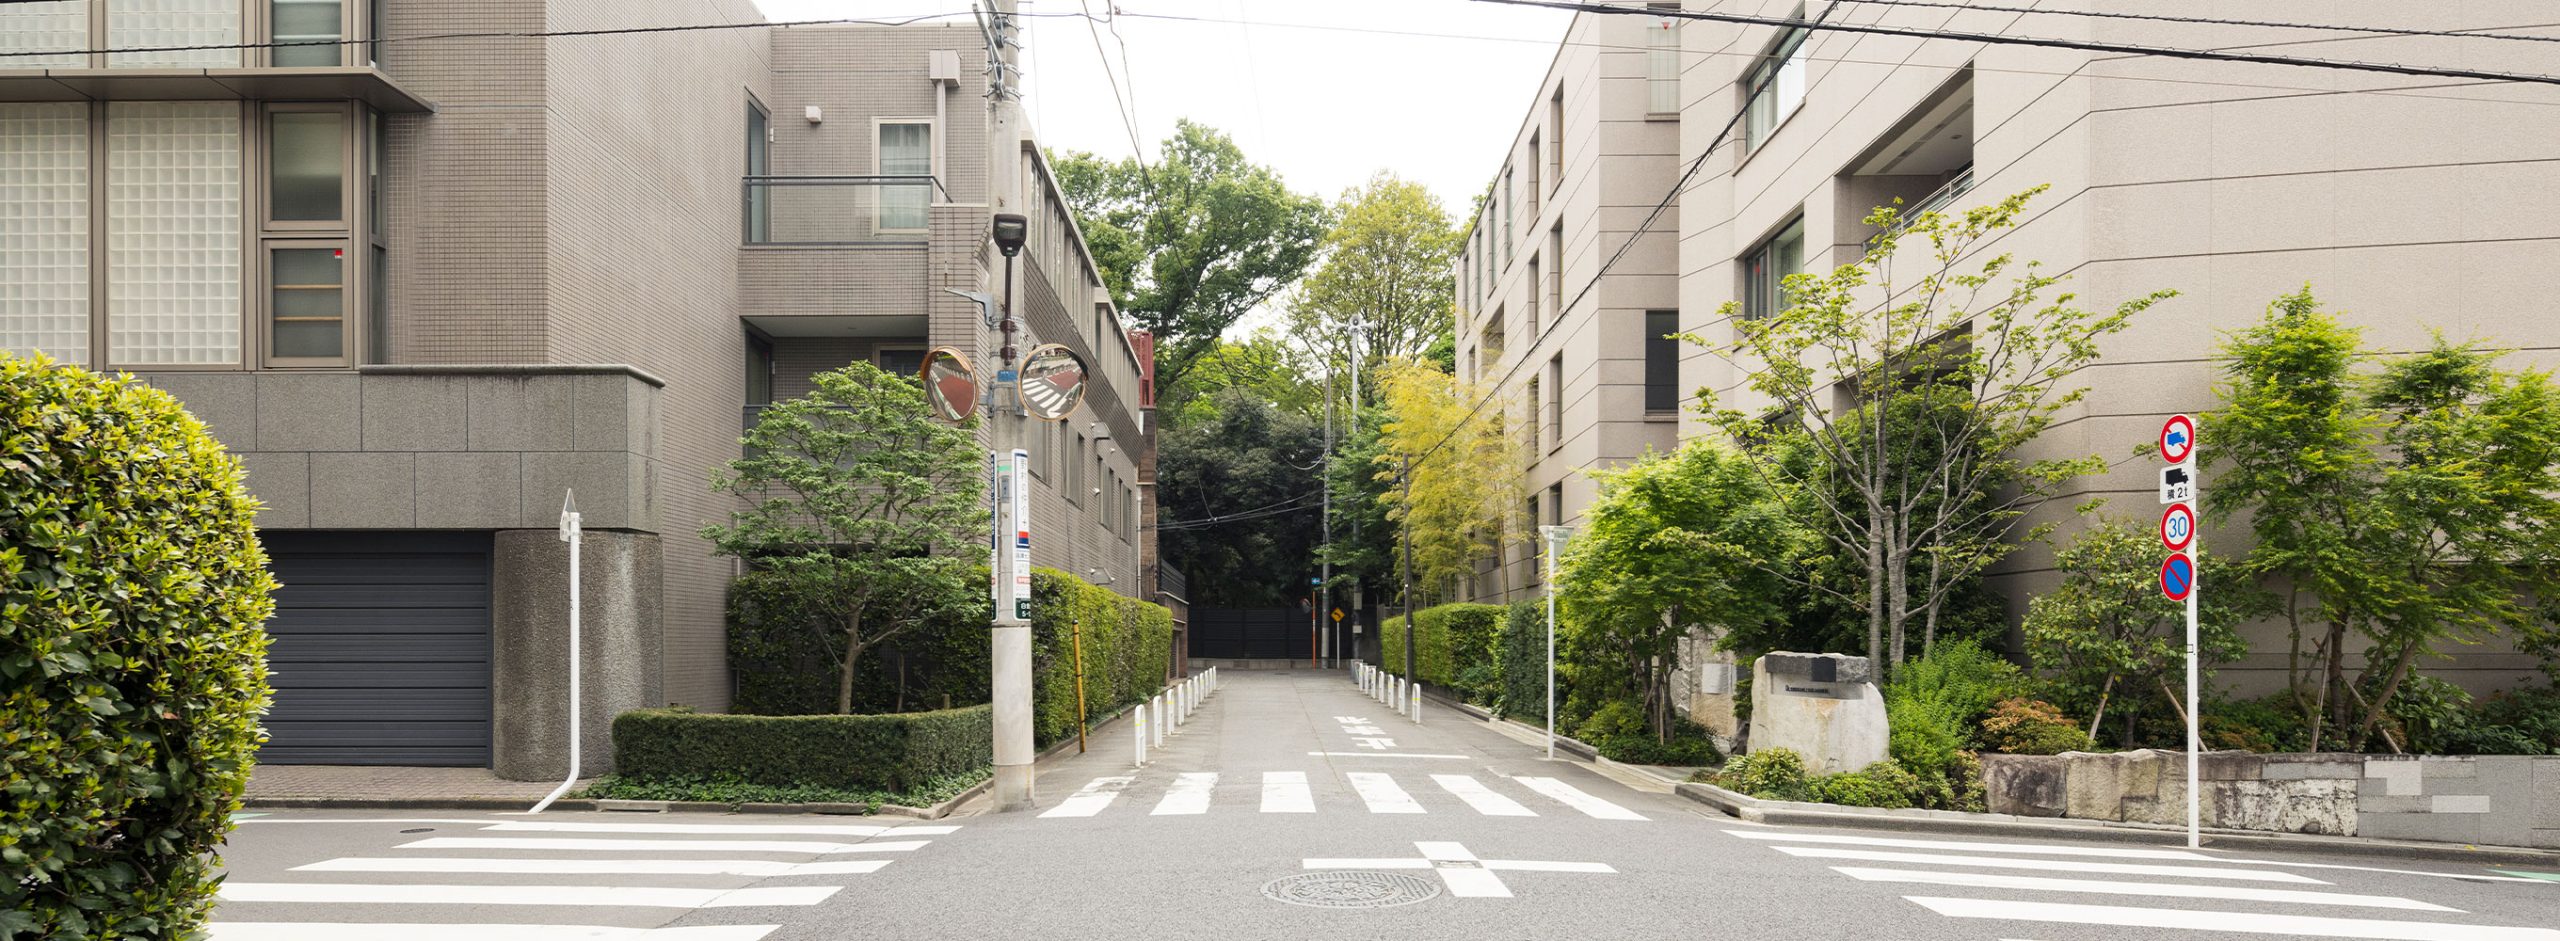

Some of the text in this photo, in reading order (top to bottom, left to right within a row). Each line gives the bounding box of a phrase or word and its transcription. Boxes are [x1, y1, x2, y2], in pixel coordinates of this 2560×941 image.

[2169, 517, 2187, 538] 30
[1333, 716, 1398, 750] 止まれ
